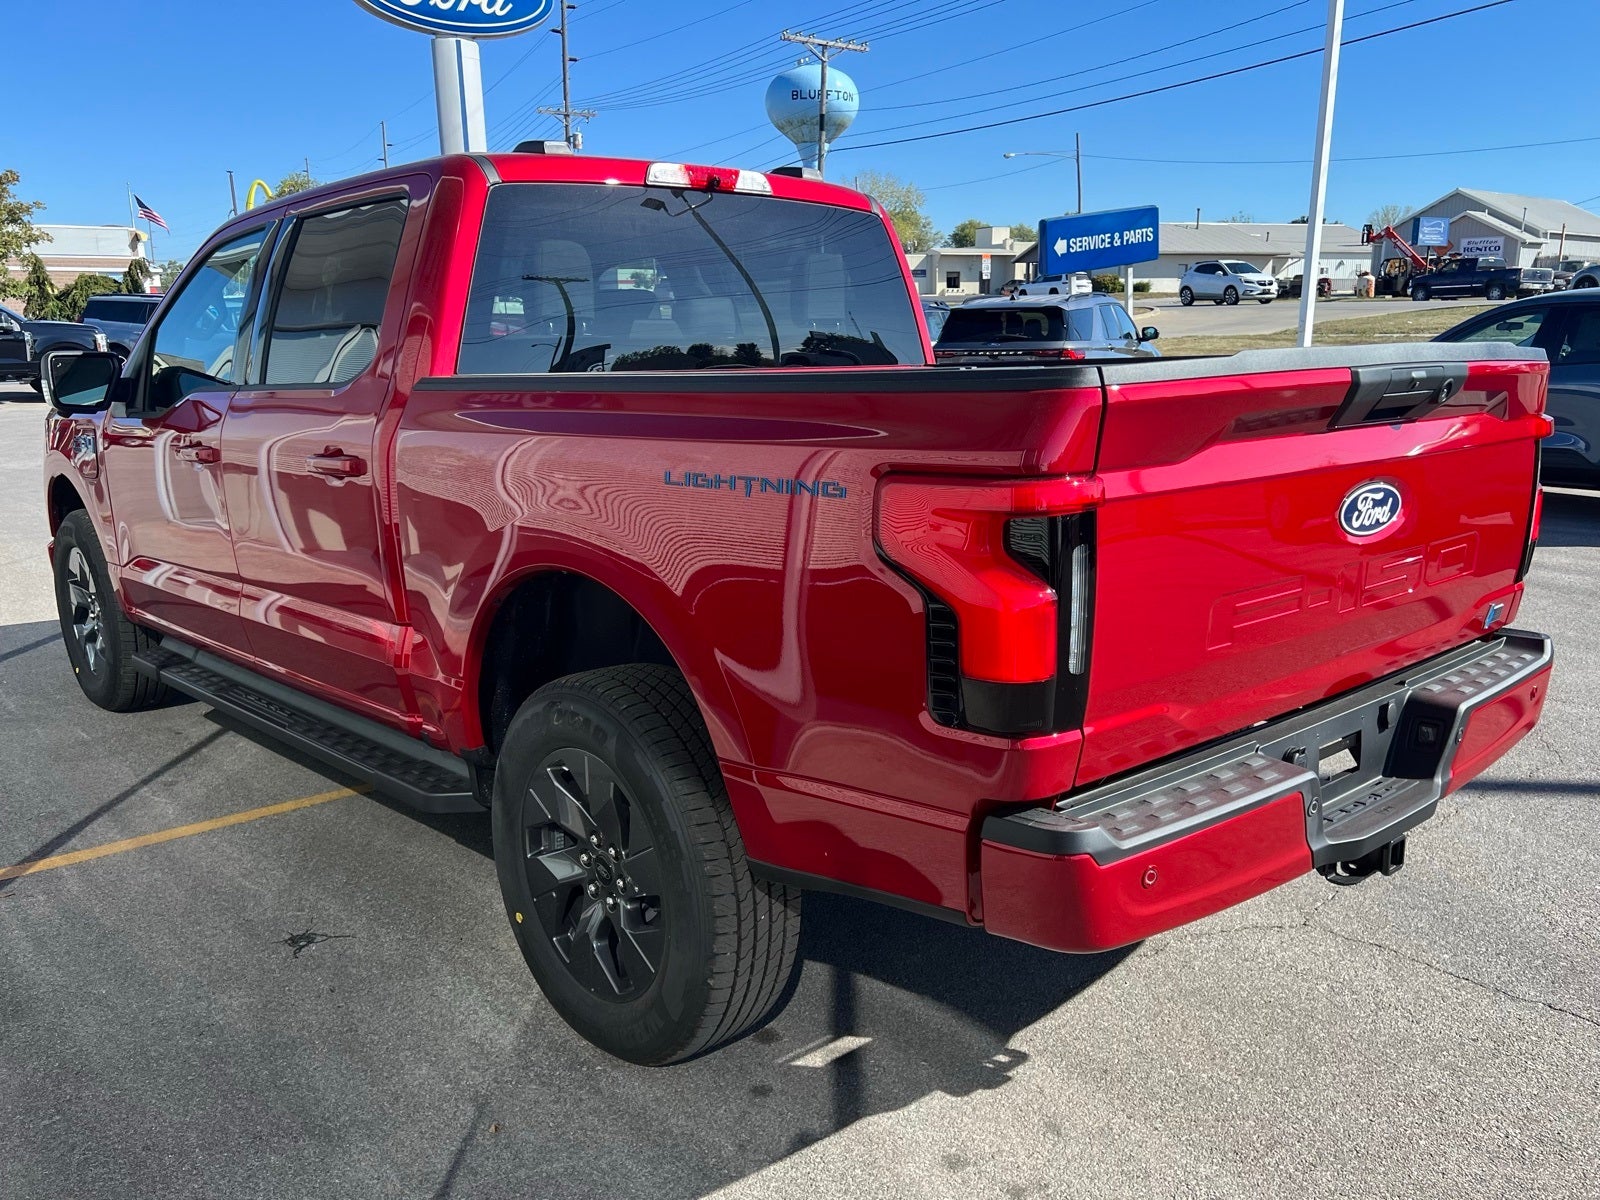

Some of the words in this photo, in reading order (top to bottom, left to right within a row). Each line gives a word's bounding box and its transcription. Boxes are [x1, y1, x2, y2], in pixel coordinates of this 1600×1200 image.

[1069, 233, 1112, 253] SERVICE
[1113, 232, 1121, 247] &
[1123, 227, 1154, 246] PARTS
[1463, 245, 1501, 253] RENTCO
[664, 470, 847, 500] LIGHTNING
[1351, 491, 1393, 529] Ford
